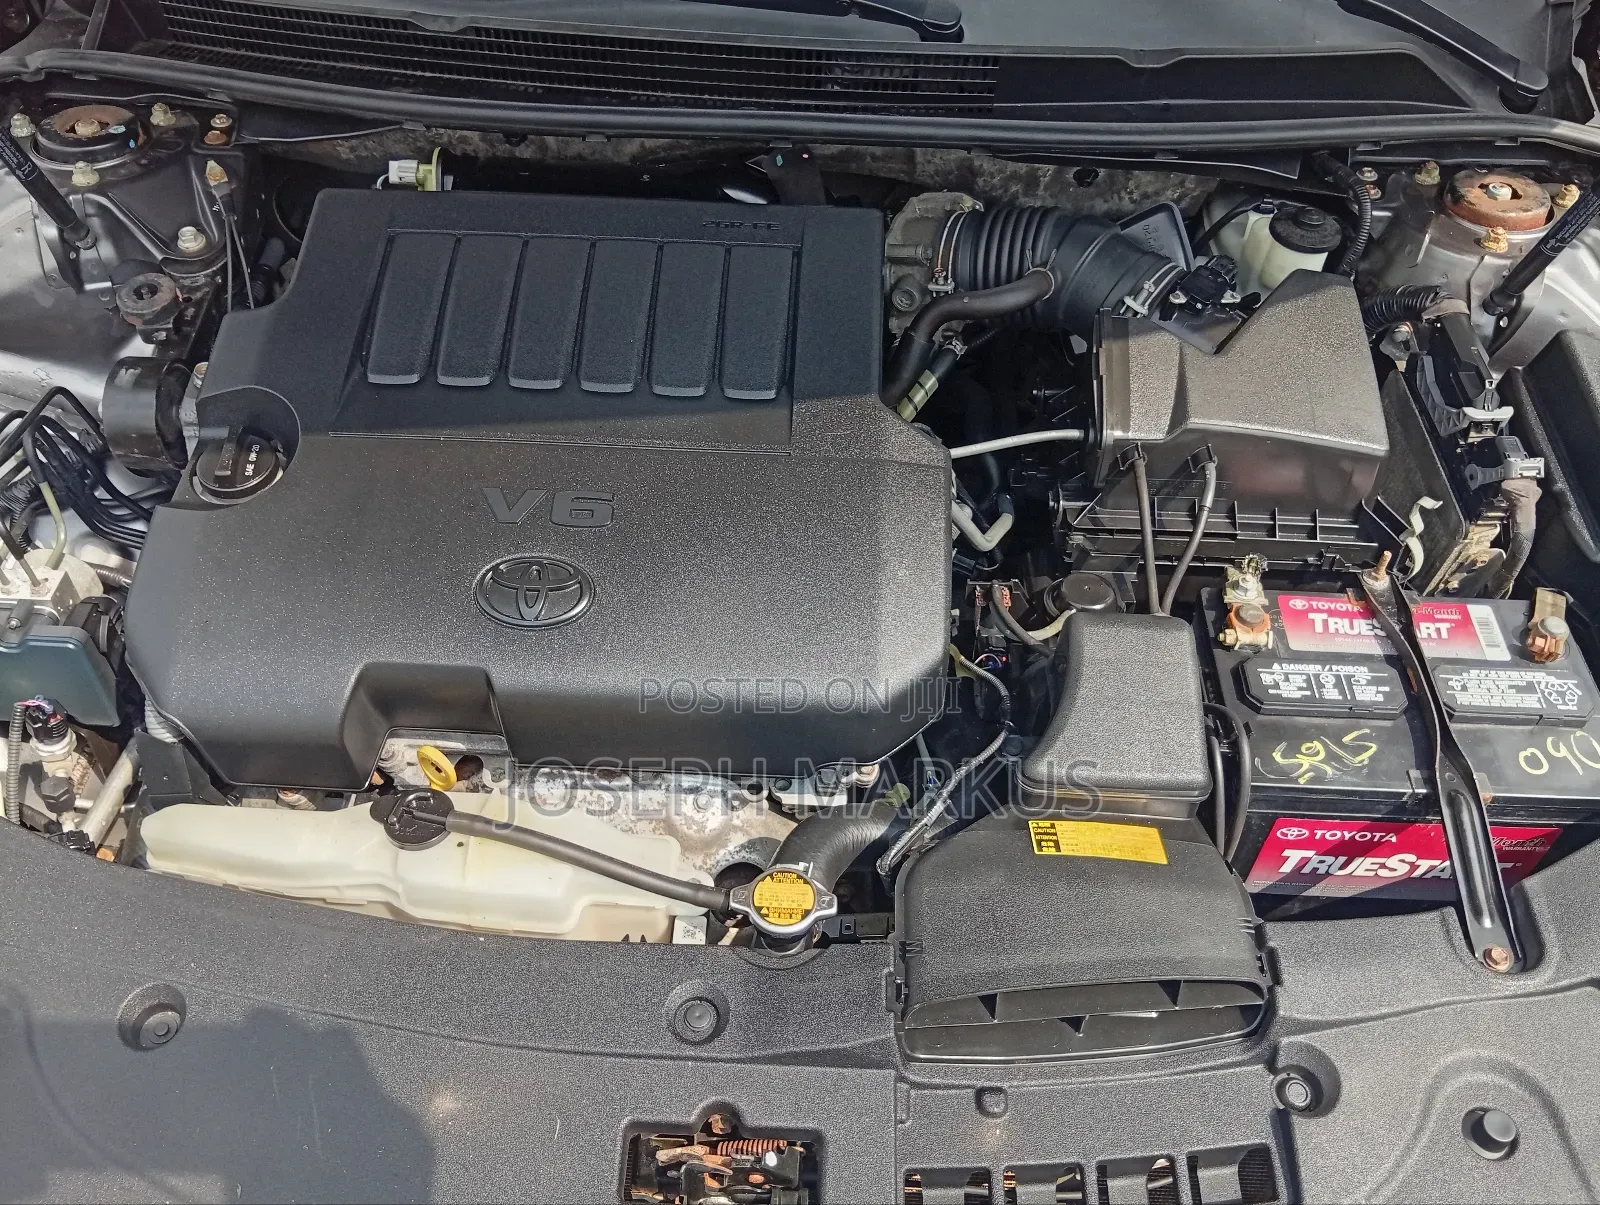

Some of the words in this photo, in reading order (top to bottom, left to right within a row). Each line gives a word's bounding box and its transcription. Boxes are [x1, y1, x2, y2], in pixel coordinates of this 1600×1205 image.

[244, 463, 255, 476] SAE
[482, 487, 614, 528] V6
[1310, 600, 1364, 612] TOYOTA
[1282, 663, 1322, 672] DANGER
[1332, 665, 1369, 673] POISON
[1313, 829, 1397, 842] TOYOTA
[1278, 849, 1513, 879] TRUESTA
